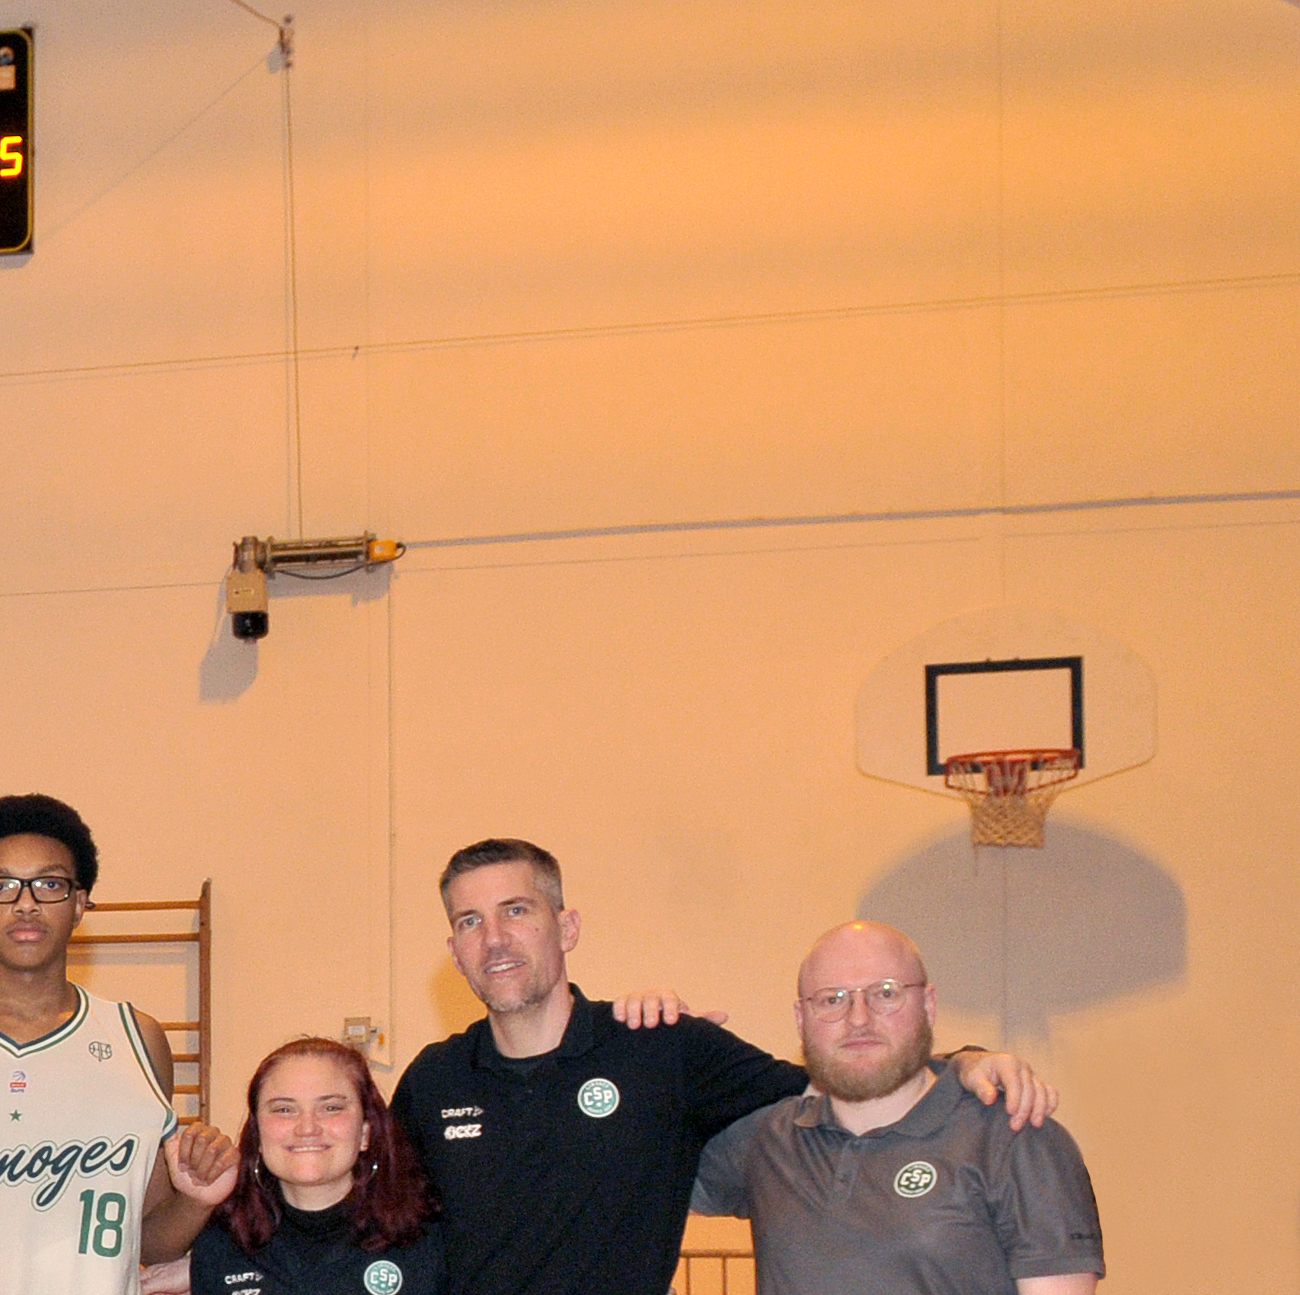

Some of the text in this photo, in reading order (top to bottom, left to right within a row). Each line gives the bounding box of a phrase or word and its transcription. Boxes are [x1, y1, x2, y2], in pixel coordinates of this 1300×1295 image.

[0, 136, 23, 177] 5
[583, 1086, 613, 1106] CSP
[900, 1169, 931, 1186] CSP
[78, 1189, 127, 1257] 18
[369, 1268, 398, 1287] CSP
